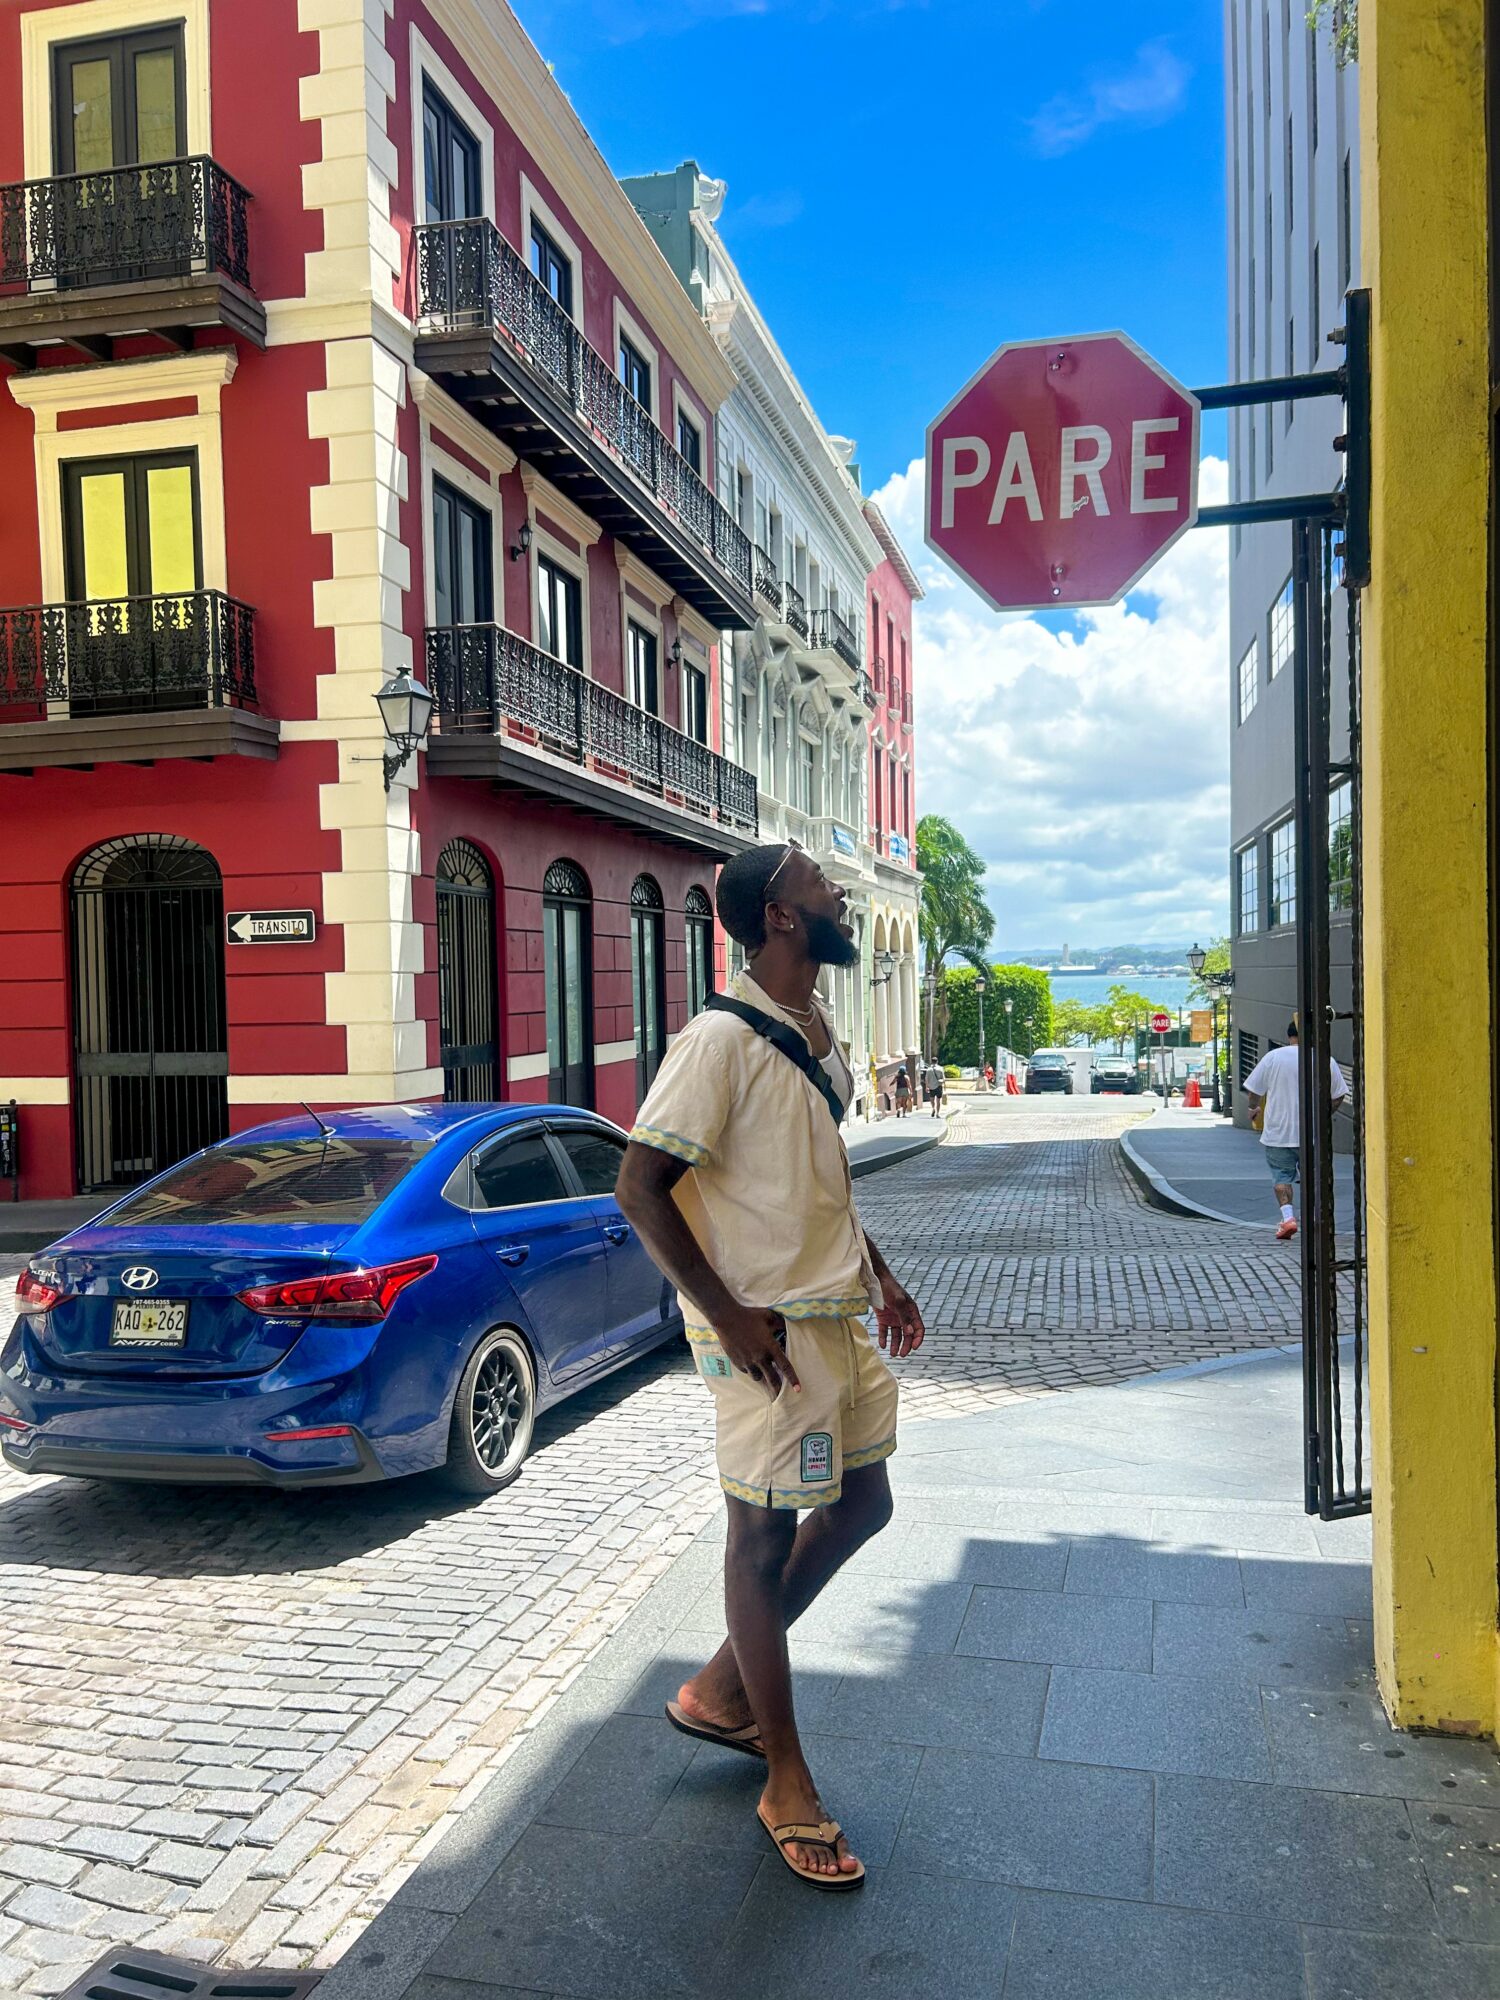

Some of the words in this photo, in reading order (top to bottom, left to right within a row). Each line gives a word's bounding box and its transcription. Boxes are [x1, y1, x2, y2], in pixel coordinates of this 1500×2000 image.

[941, 417, 1179, 528] PARE
[1152, 1019, 1169, 1027] PARE
[115, 1310, 141, 1330] KAQ
[158, 1310, 184, 1331] 262
